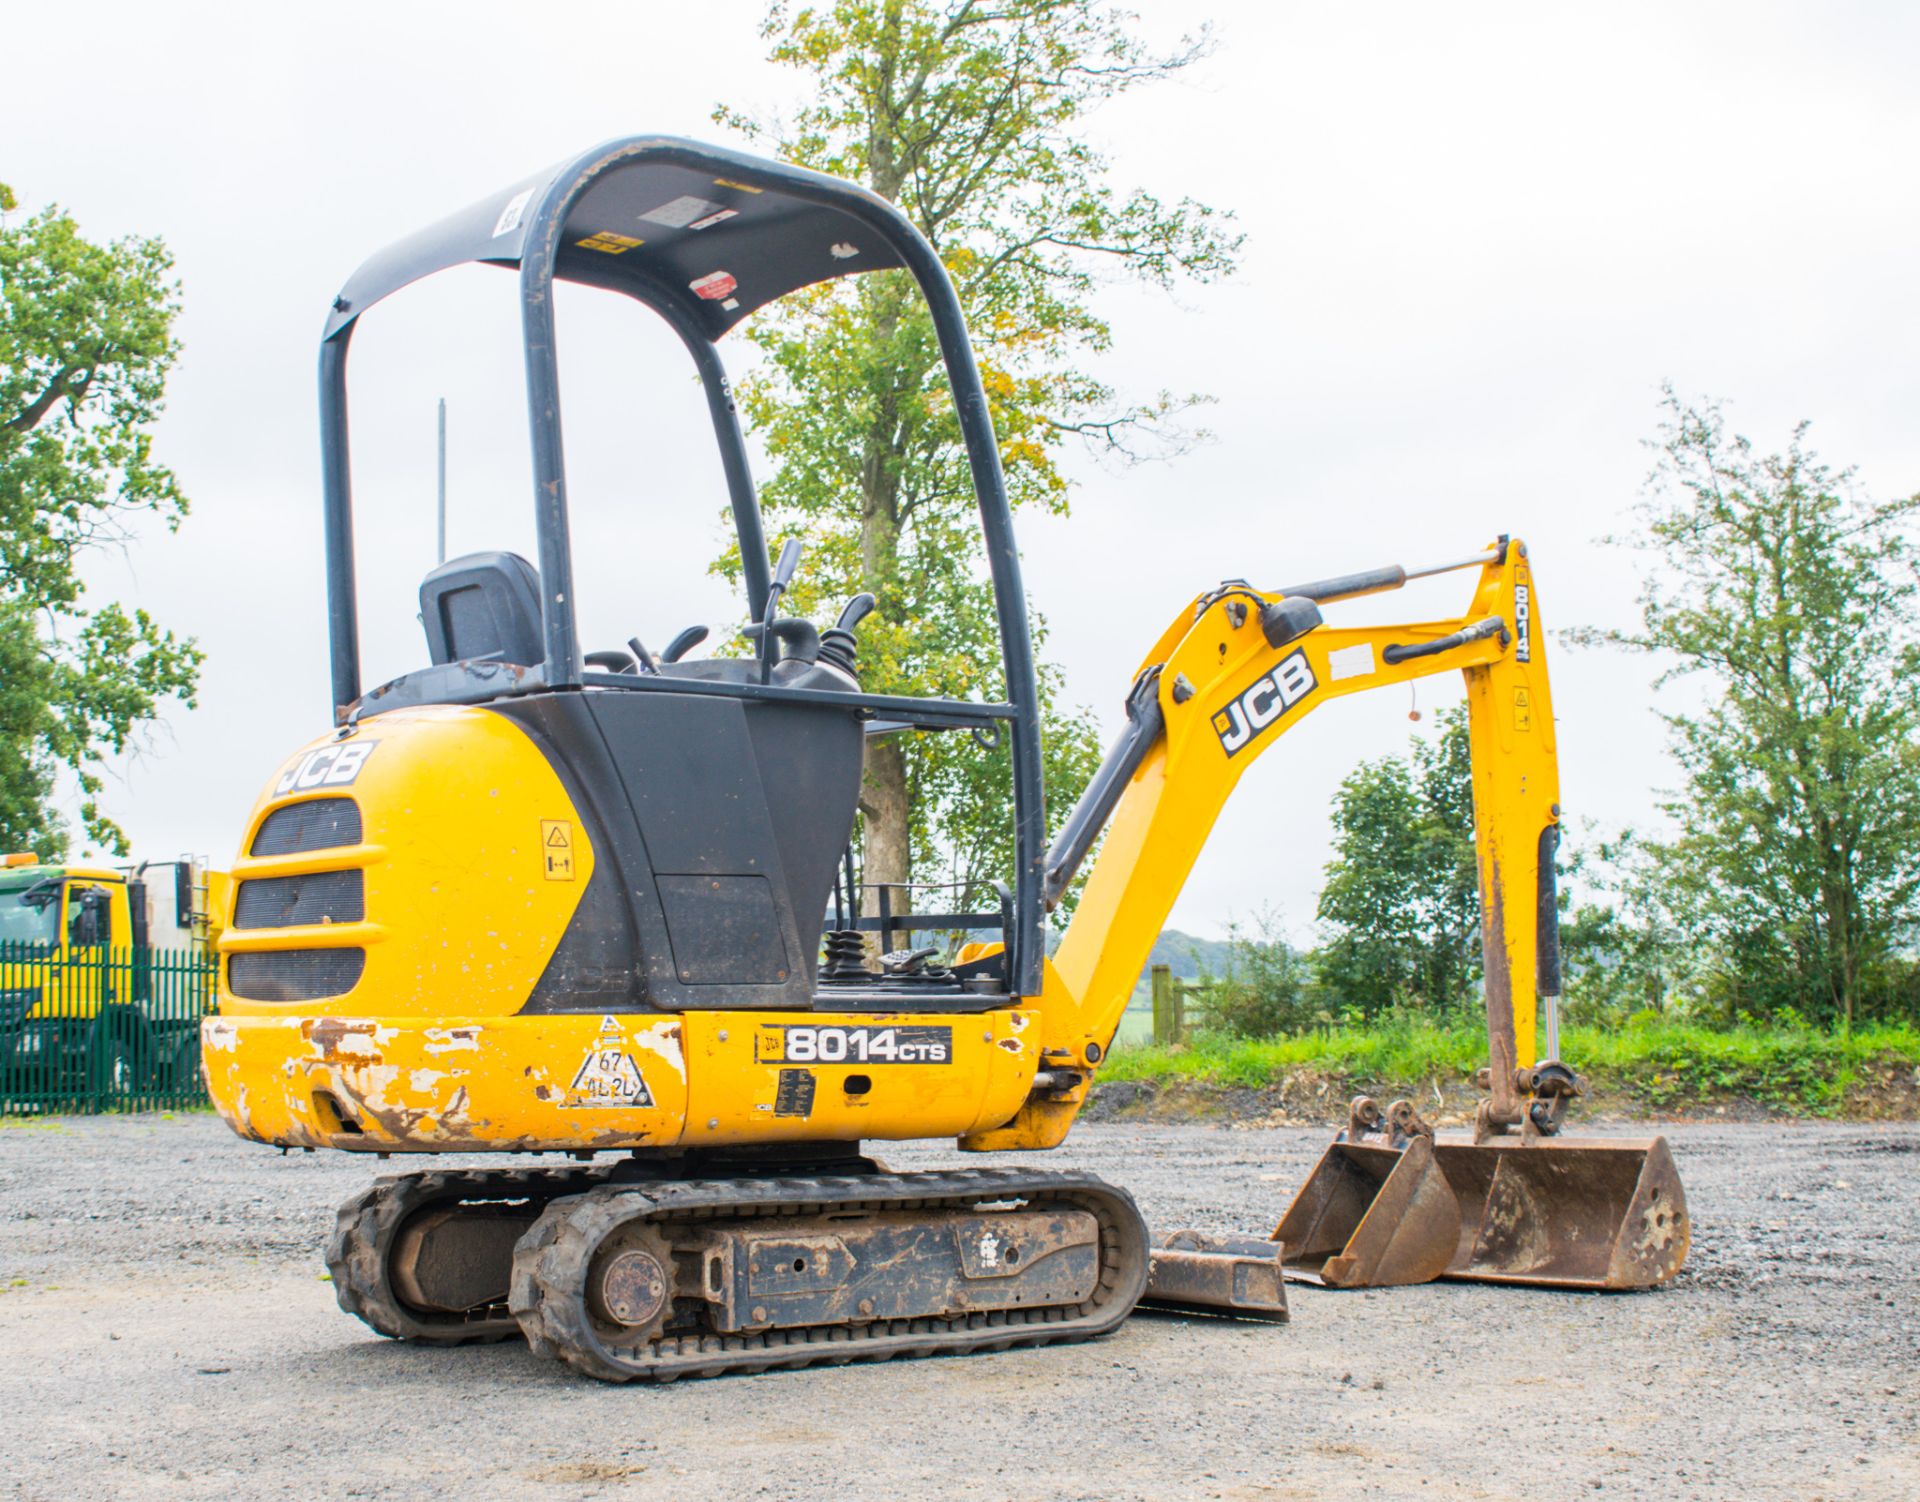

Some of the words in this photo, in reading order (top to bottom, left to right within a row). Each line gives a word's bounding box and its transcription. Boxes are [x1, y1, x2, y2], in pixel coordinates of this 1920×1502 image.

[1515, 586, 1530, 652] 8014
[1221, 653, 1315, 752] JCB
[276, 741, 375, 794] JCB
[599, 1052, 622, 1072] 67
[786, 1028, 898, 1062] 8014
[899, 1043, 947, 1061] CTS
